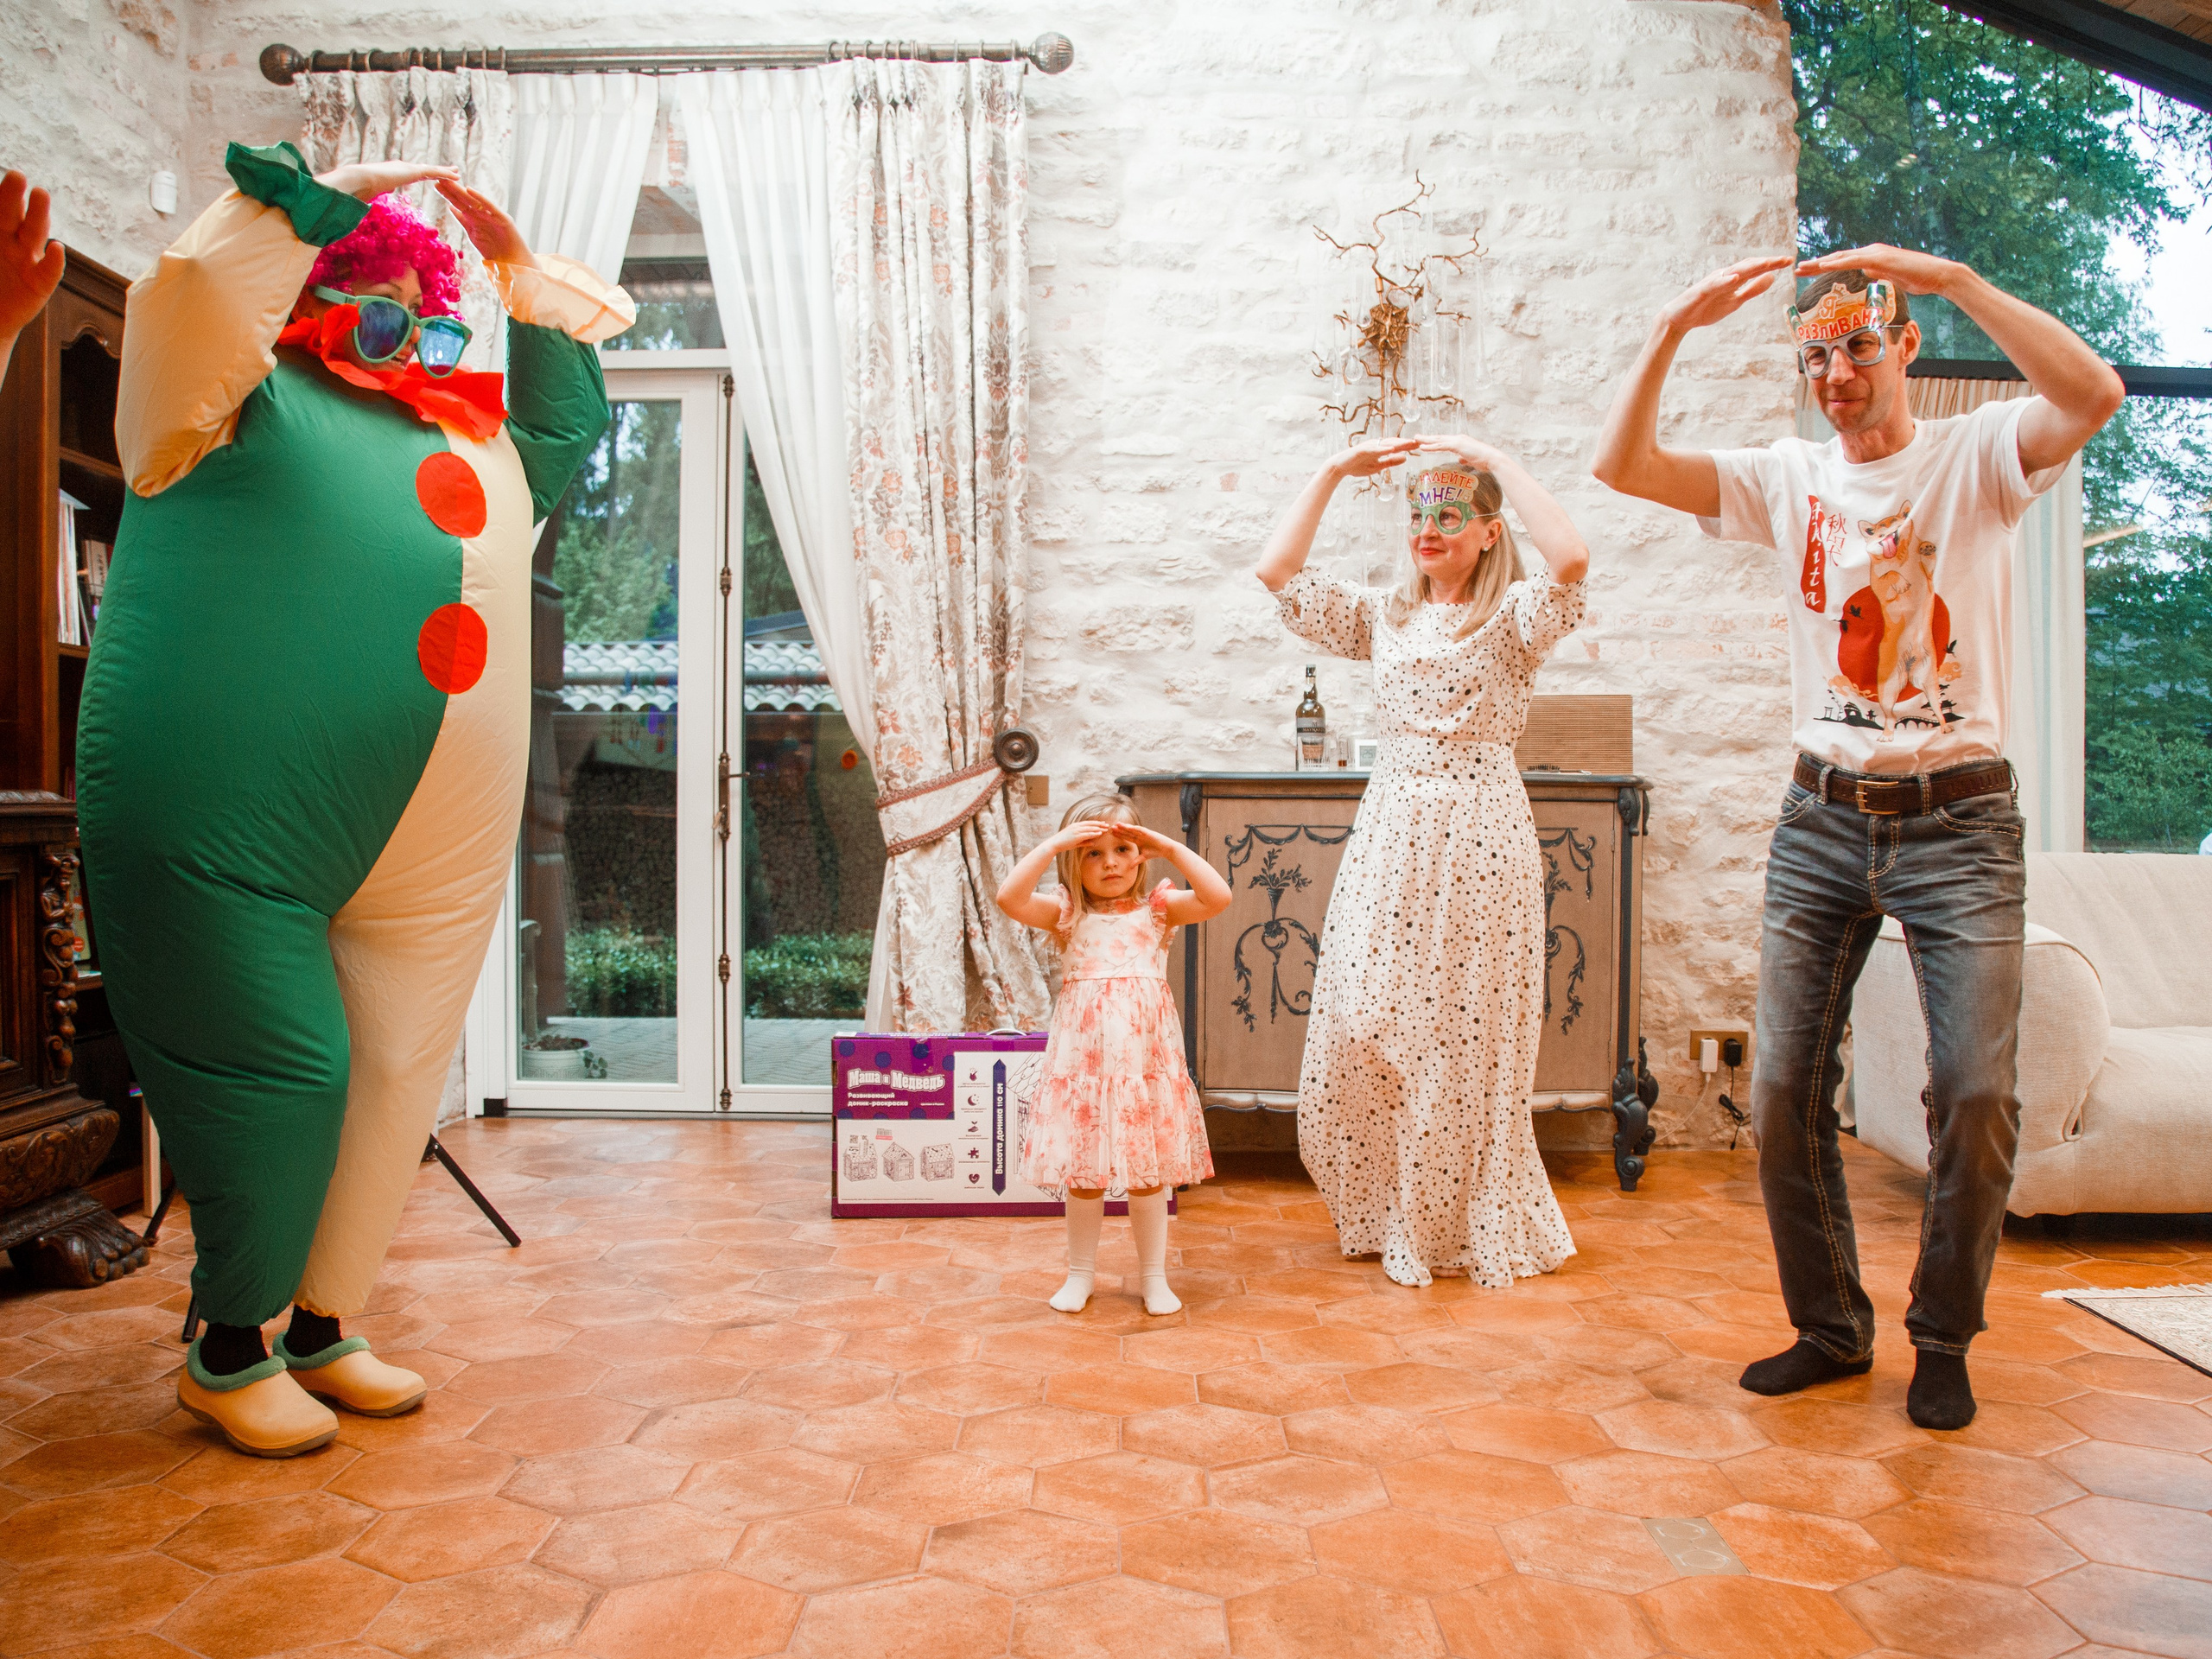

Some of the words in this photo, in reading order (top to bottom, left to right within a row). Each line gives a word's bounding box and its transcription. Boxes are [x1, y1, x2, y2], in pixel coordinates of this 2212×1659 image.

[1820, 295, 1837, 319] Я
[1419, 471, 1475, 489] НАЛЕЙТЕ
[1419, 486, 1463, 507] МНЕ!
[849, 1069, 881, 1089] Маша
[882, 1074, 891, 1084] и
[891, 1070, 945, 1091] Медведь
[996, 1083, 1004, 1095] см
[996, 1108, 1005, 1141] домика
[995, 1142, 1004, 1174] Высота
